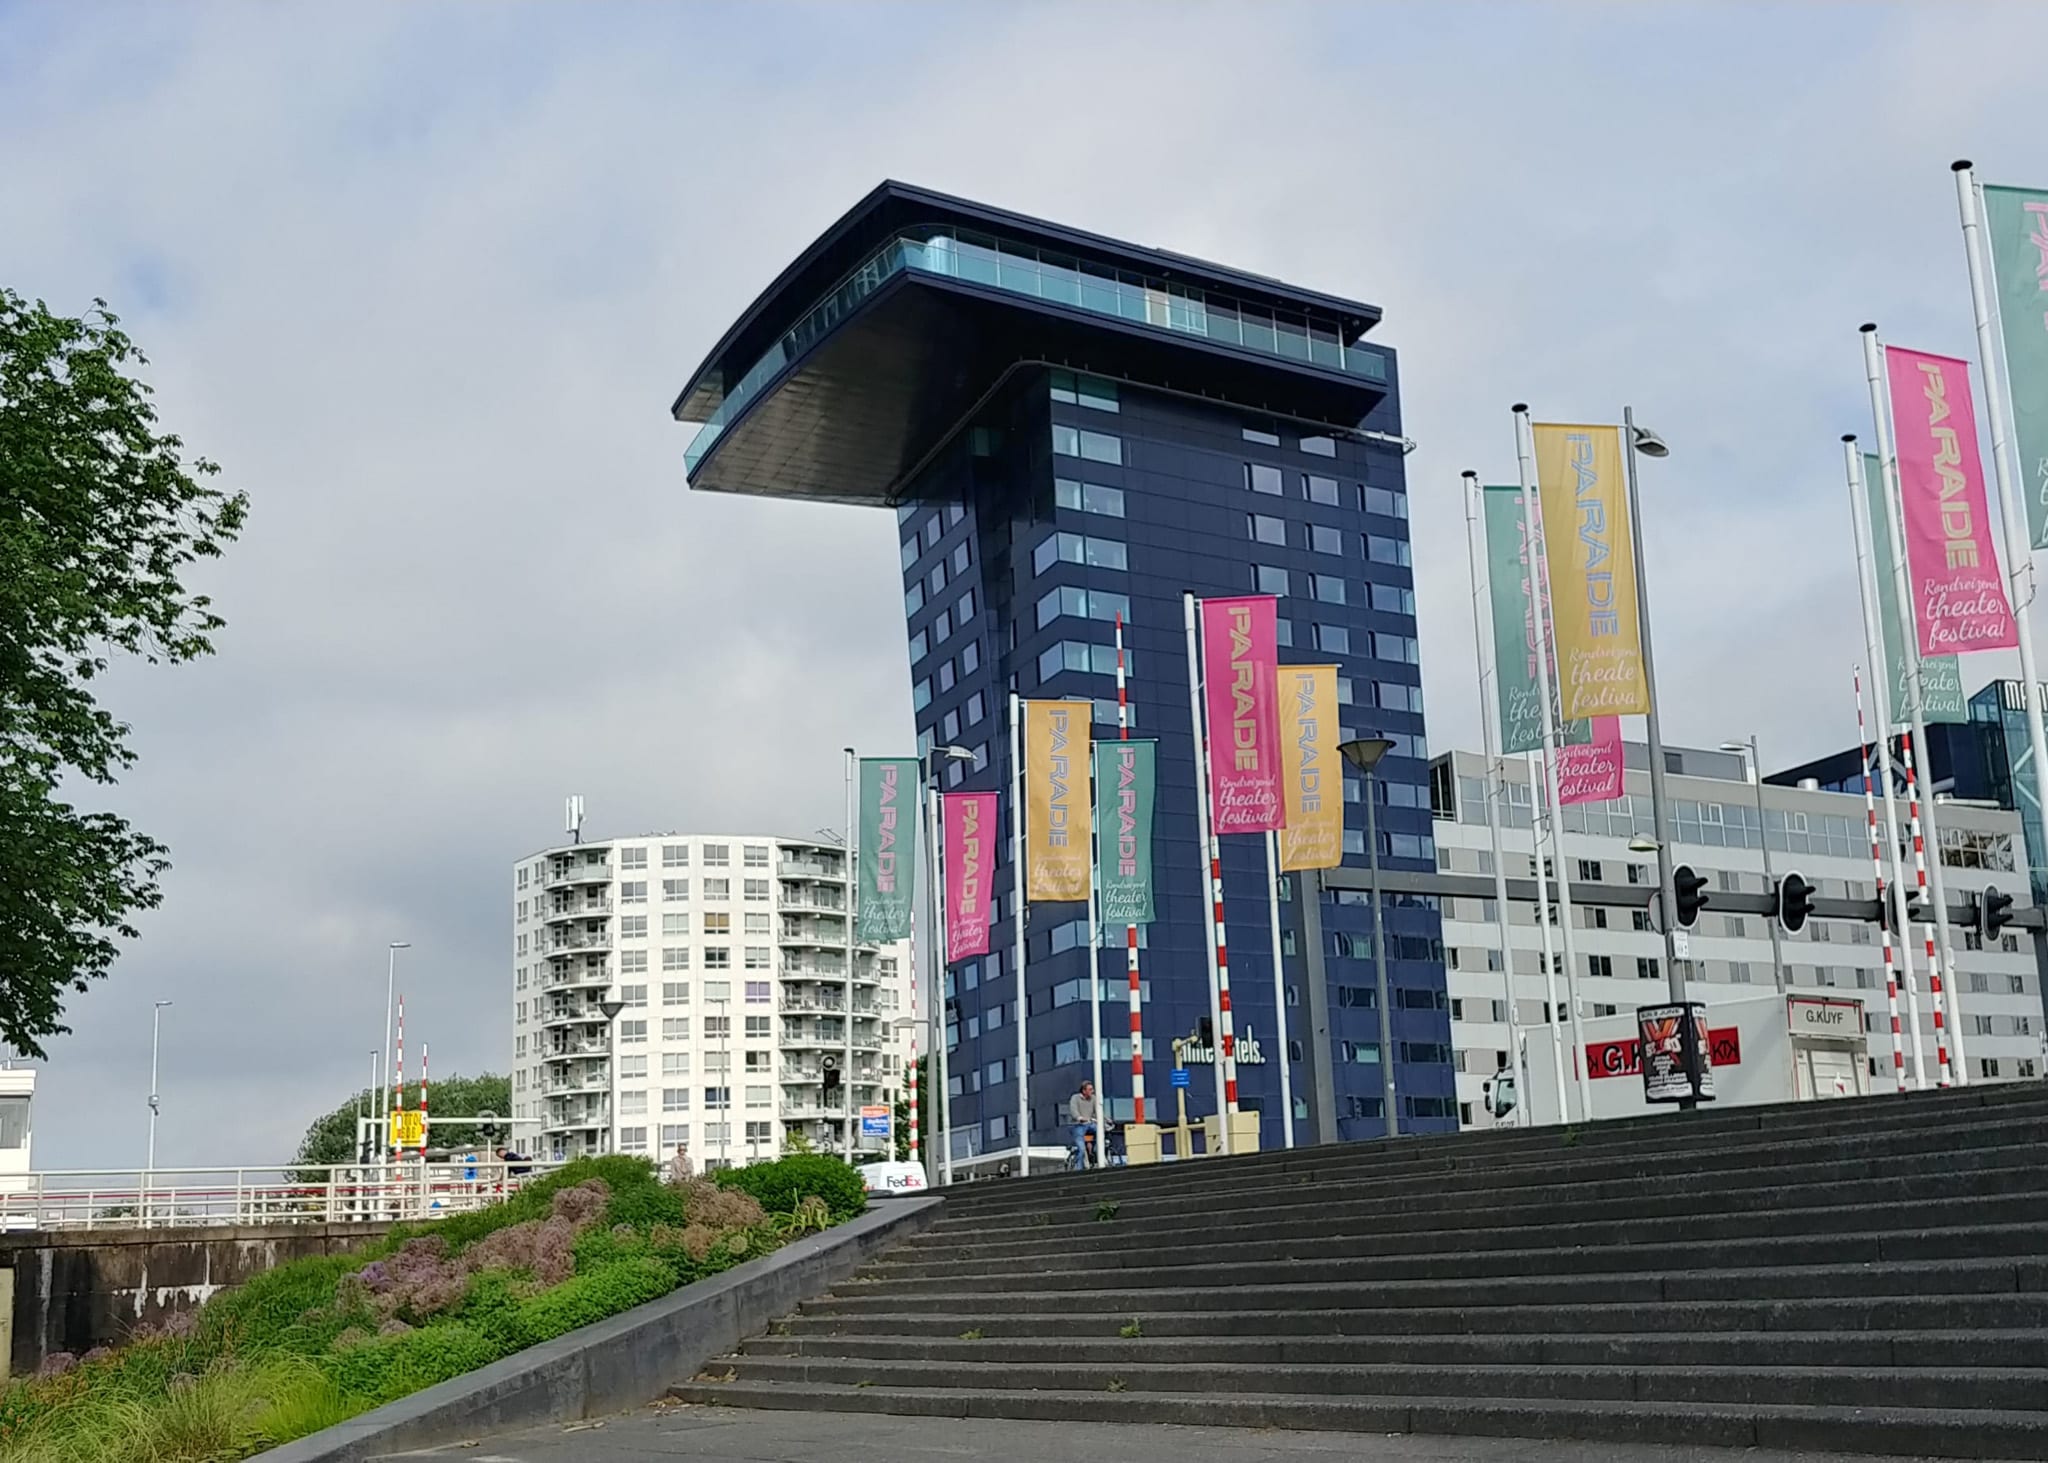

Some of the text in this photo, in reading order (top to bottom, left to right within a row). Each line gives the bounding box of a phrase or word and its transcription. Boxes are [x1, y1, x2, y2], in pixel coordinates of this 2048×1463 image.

[1916, 362, 1979, 570] PARADE
[1566, 433, 1619, 637] PARADE
[1924, 577, 1999, 595] Rondreizend
[1926, 592, 2005, 619] theater
[1928, 616, 2005, 650] festival
[1571, 659, 1634, 685] theate
[1227, 606, 1258, 771] PARADE
[1572, 687, 1636, 715] festiva
[1296, 673, 1321, 814] PARADE
[1049, 710, 1069, 847] PARADE
[1220, 787, 1276, 807] theater
[1117, 747, 1137, 877] PARADE
[1219, 805, 1277, 830] festival
[876, 764, 897, 892] PARADE
[960, 800, 979, 915] PARADE
[1106, 888, 1146, 903] theater
[1105, 902, 1147, 921] festival
[1806, 1009, 1843, 1024] G.KUYF
[887, 1175, 921, 1188] FedEx
